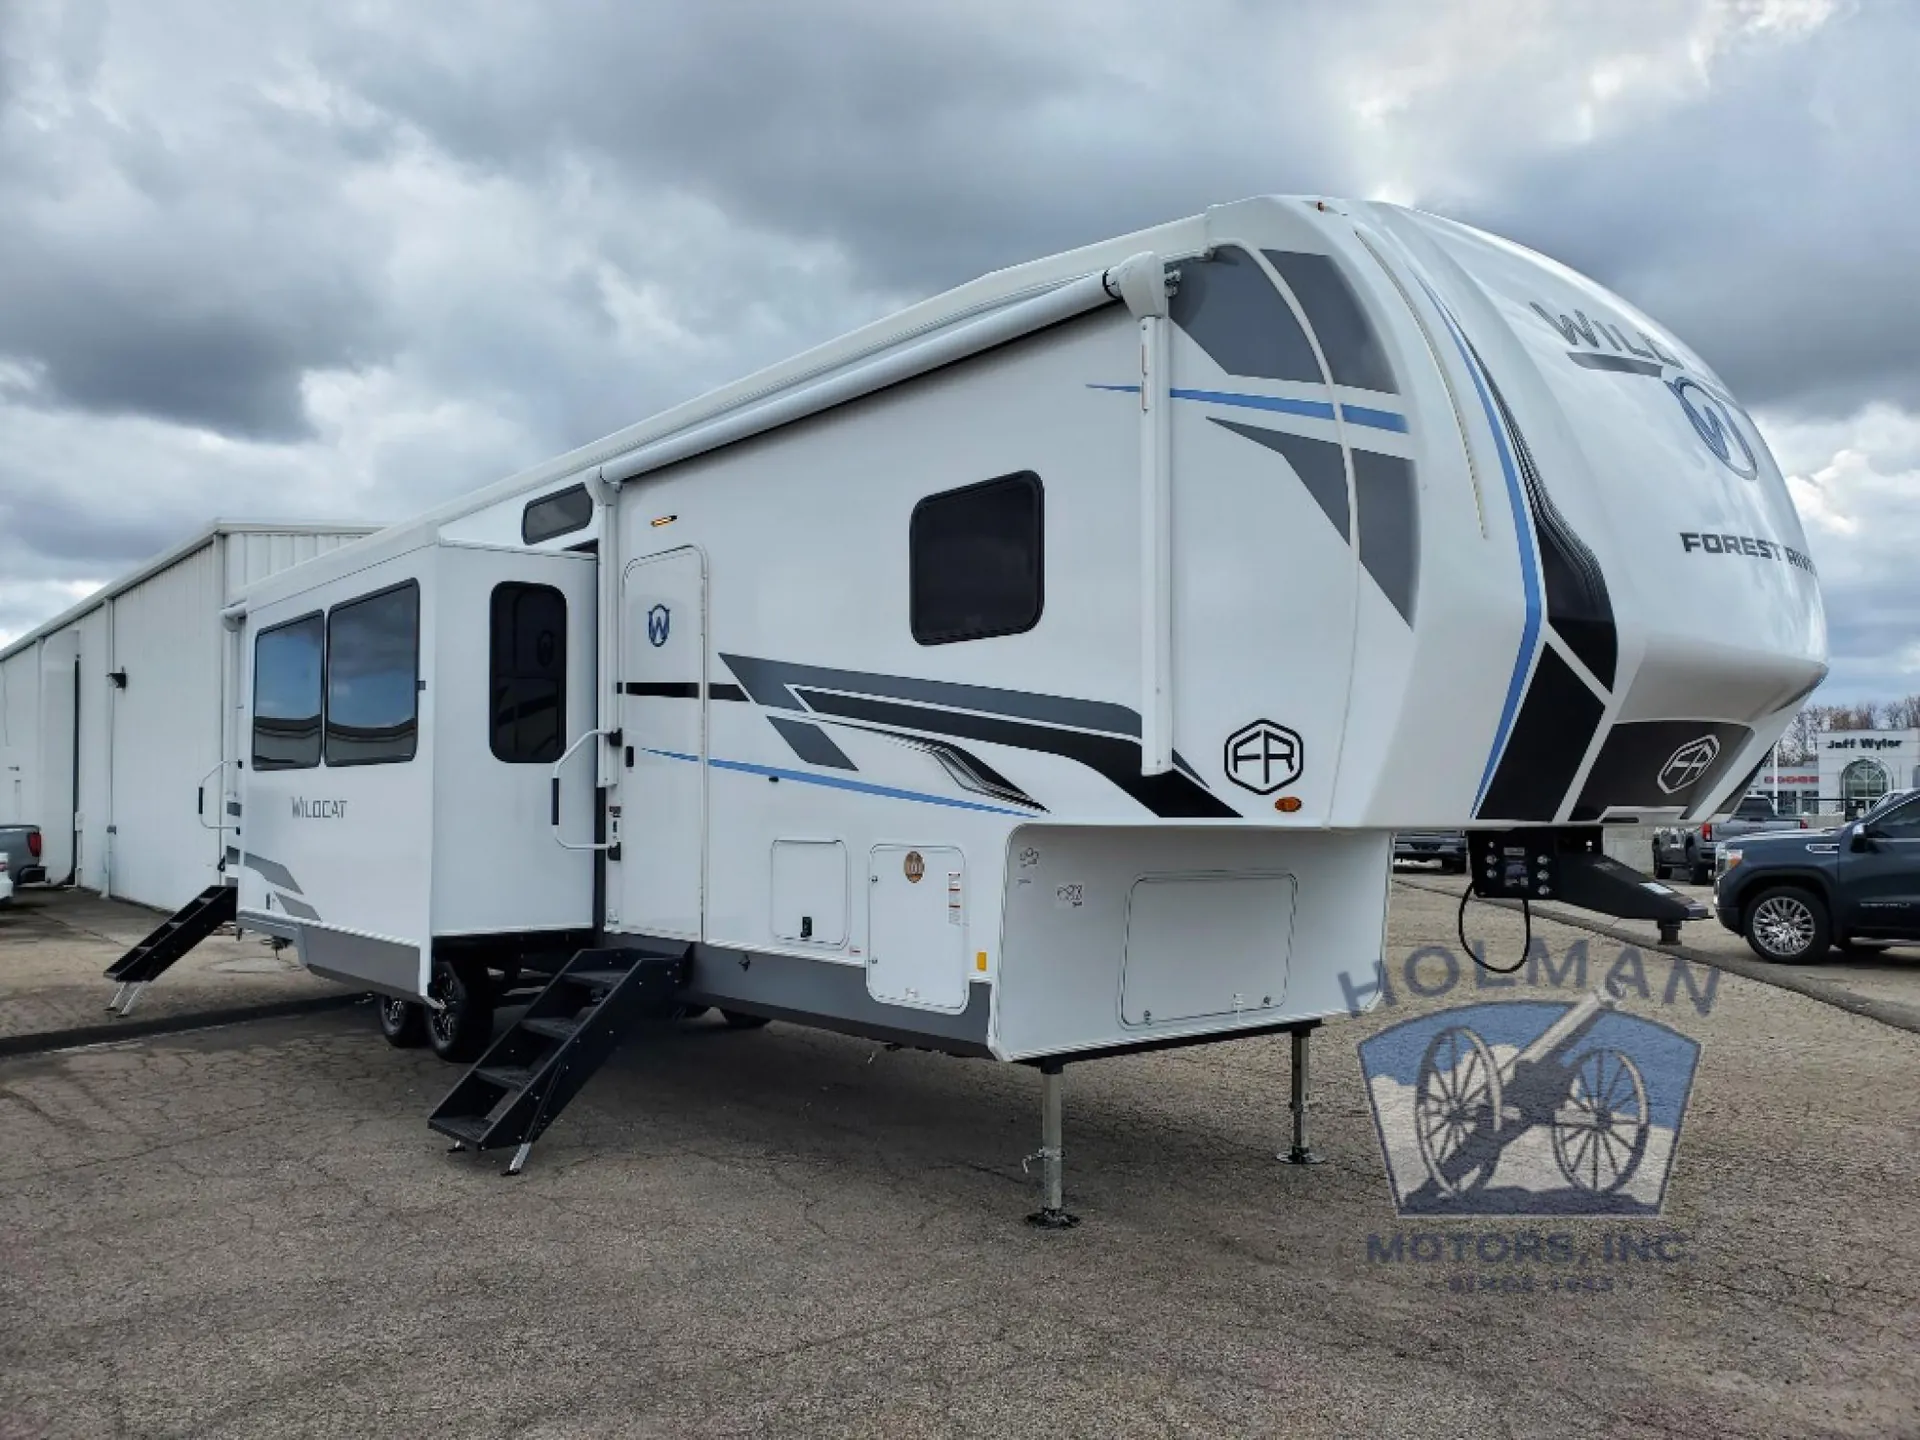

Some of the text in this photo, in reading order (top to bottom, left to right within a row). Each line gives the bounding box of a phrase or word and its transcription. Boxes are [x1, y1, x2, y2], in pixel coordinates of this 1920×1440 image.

[1680, 532, 1782, 562] FOREST
[1827, 738, 1902, 750] Jeff Wyler
[290, 796, 348, 818] WILDCAT
